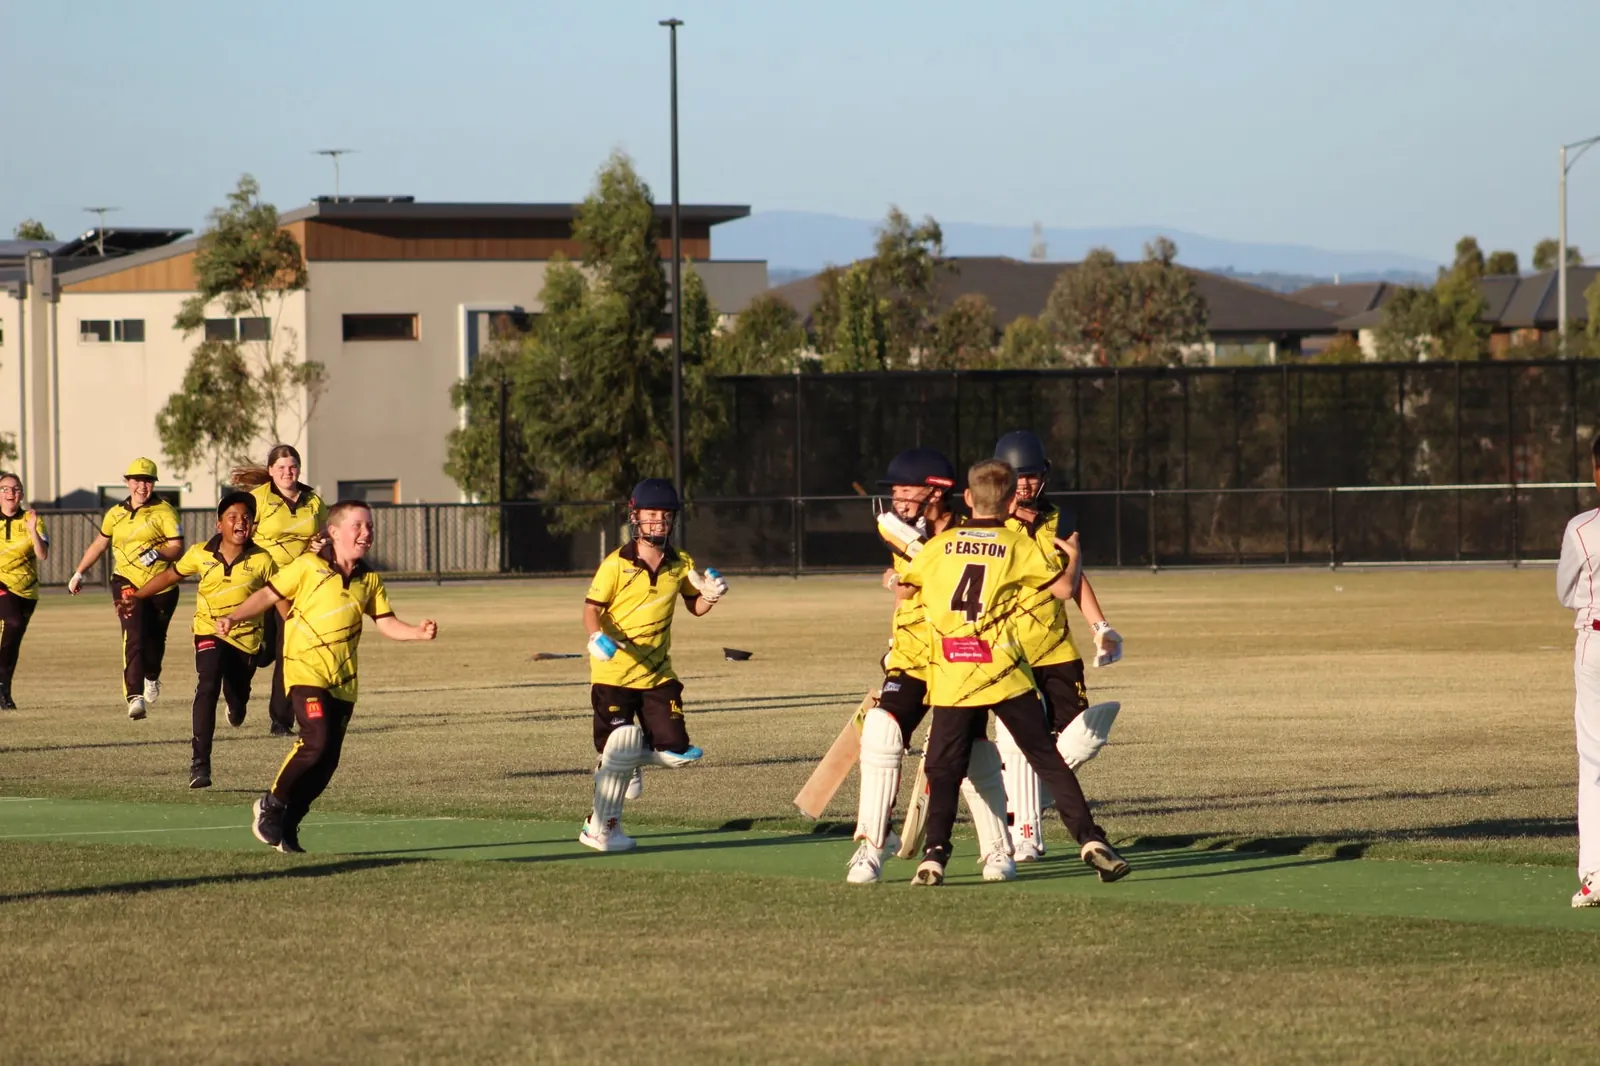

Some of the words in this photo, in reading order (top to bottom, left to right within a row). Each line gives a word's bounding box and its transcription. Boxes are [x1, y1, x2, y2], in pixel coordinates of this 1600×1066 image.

[945, 541, 952, 554] C
[956, 541, 1006, 558] EASTON
[951, 563, 985, 622] 4
